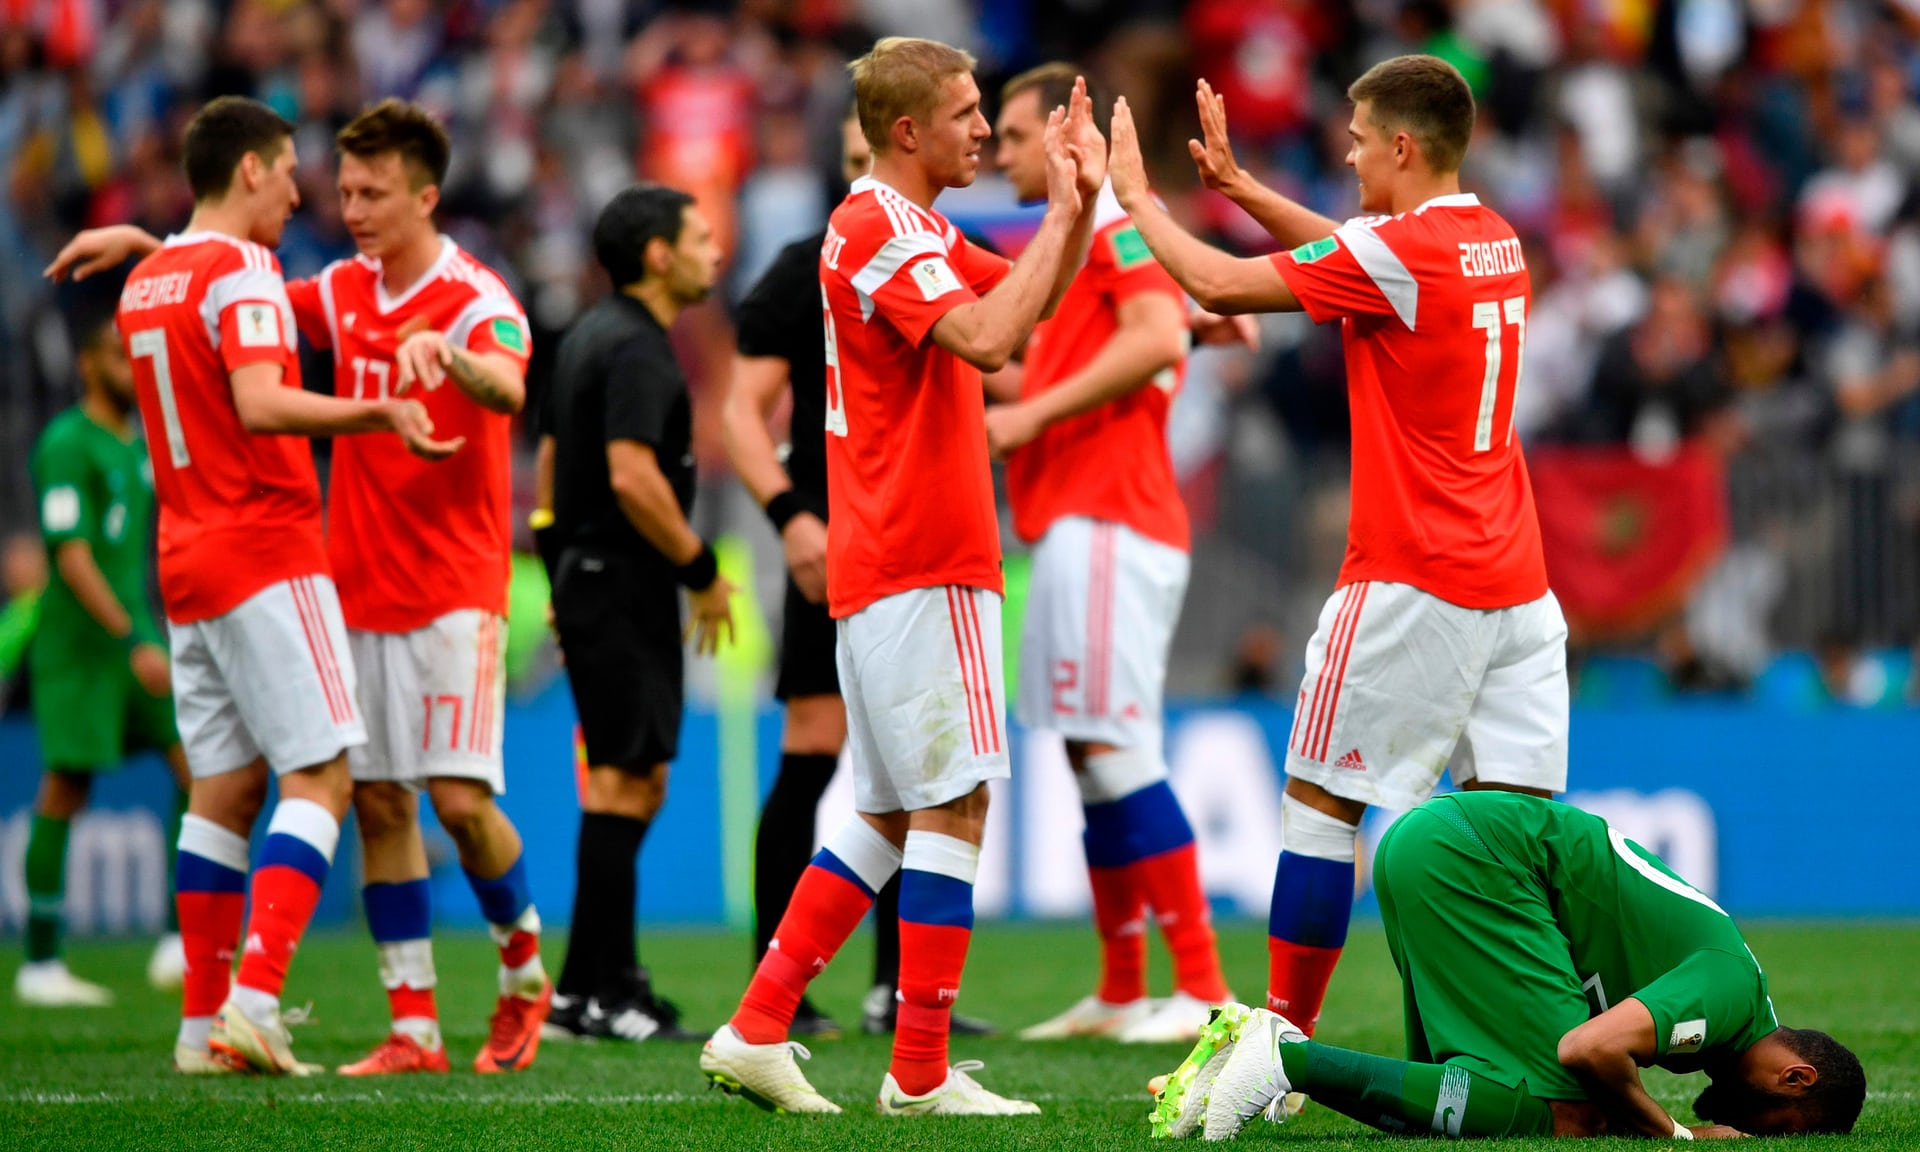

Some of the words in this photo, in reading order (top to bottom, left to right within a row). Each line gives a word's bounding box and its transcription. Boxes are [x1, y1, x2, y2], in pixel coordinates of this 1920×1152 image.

[1457, 236, 1526, 277] ZOBNIN
[129, 326, 192, 470] 7
[1471, 295, 1526, 452] 11
[421, 694, 463, 752] 17
